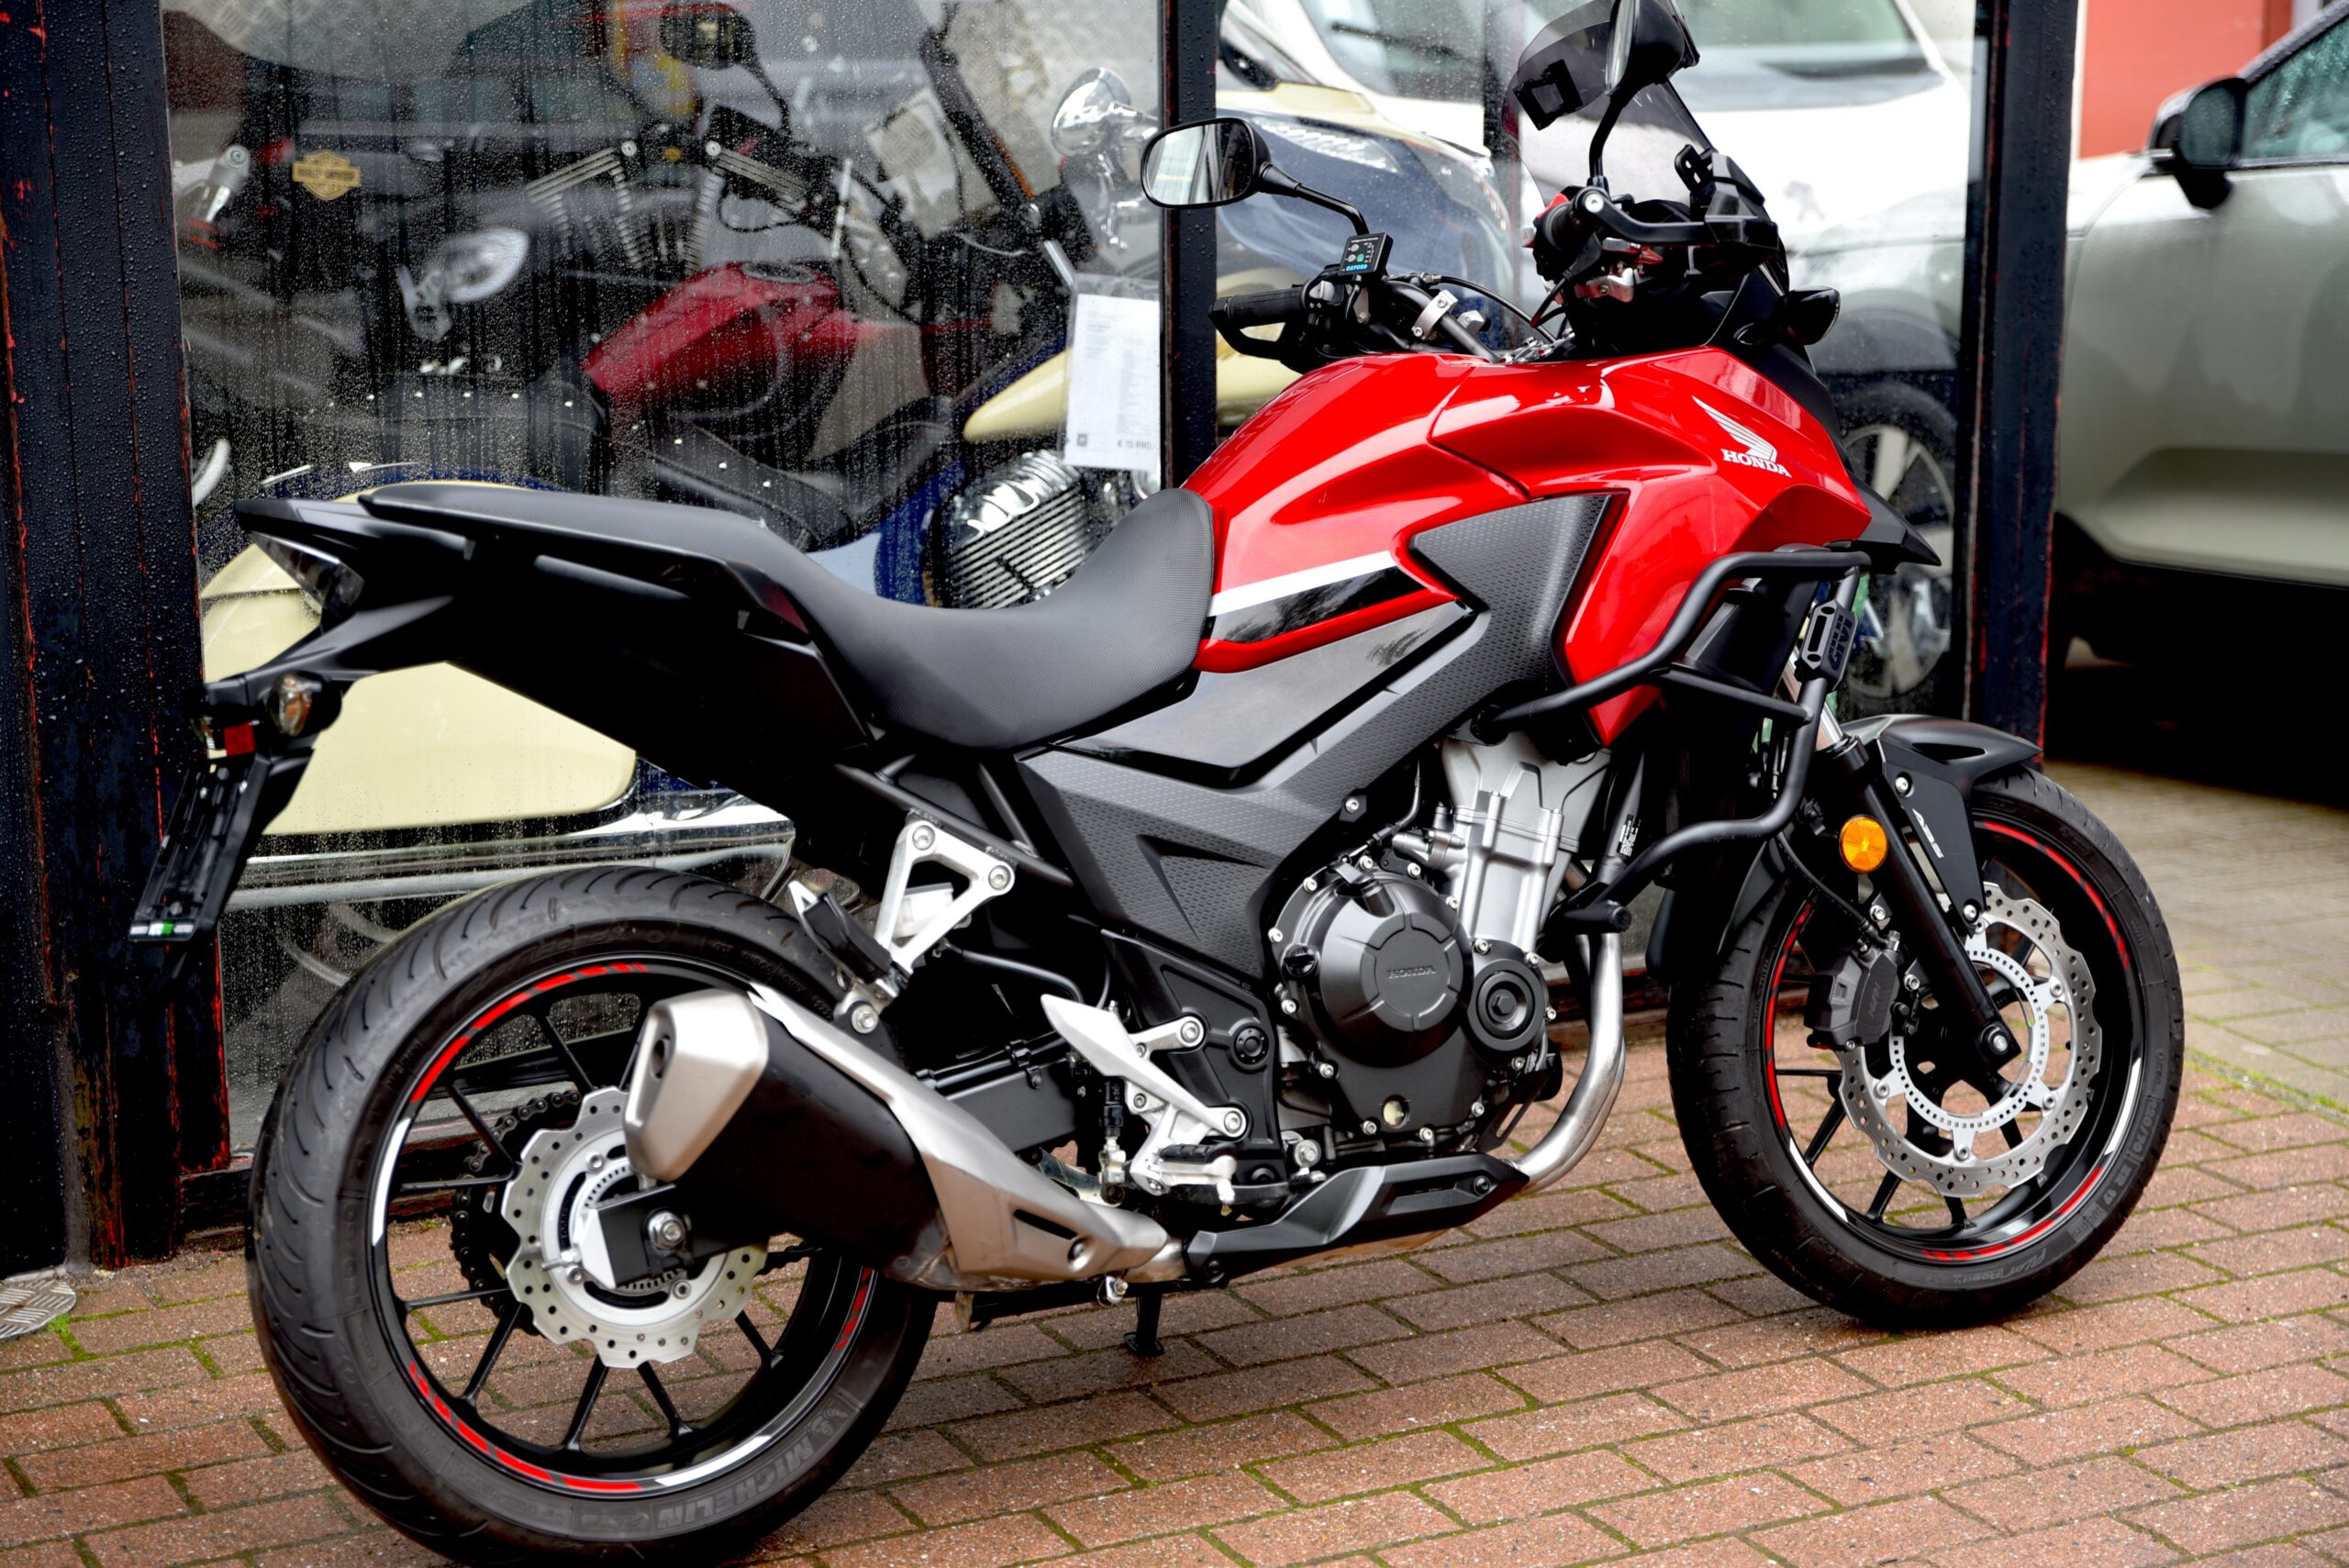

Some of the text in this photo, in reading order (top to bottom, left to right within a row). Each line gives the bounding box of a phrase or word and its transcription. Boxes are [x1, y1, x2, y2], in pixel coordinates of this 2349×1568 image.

[1720, 449, 1792, 478] HONDA
[1828, 614, 1853, 671] GIVI
[1387, 966, 1437, 980] HONDA
[657, 1435, 815, 1529] MICHELIN
